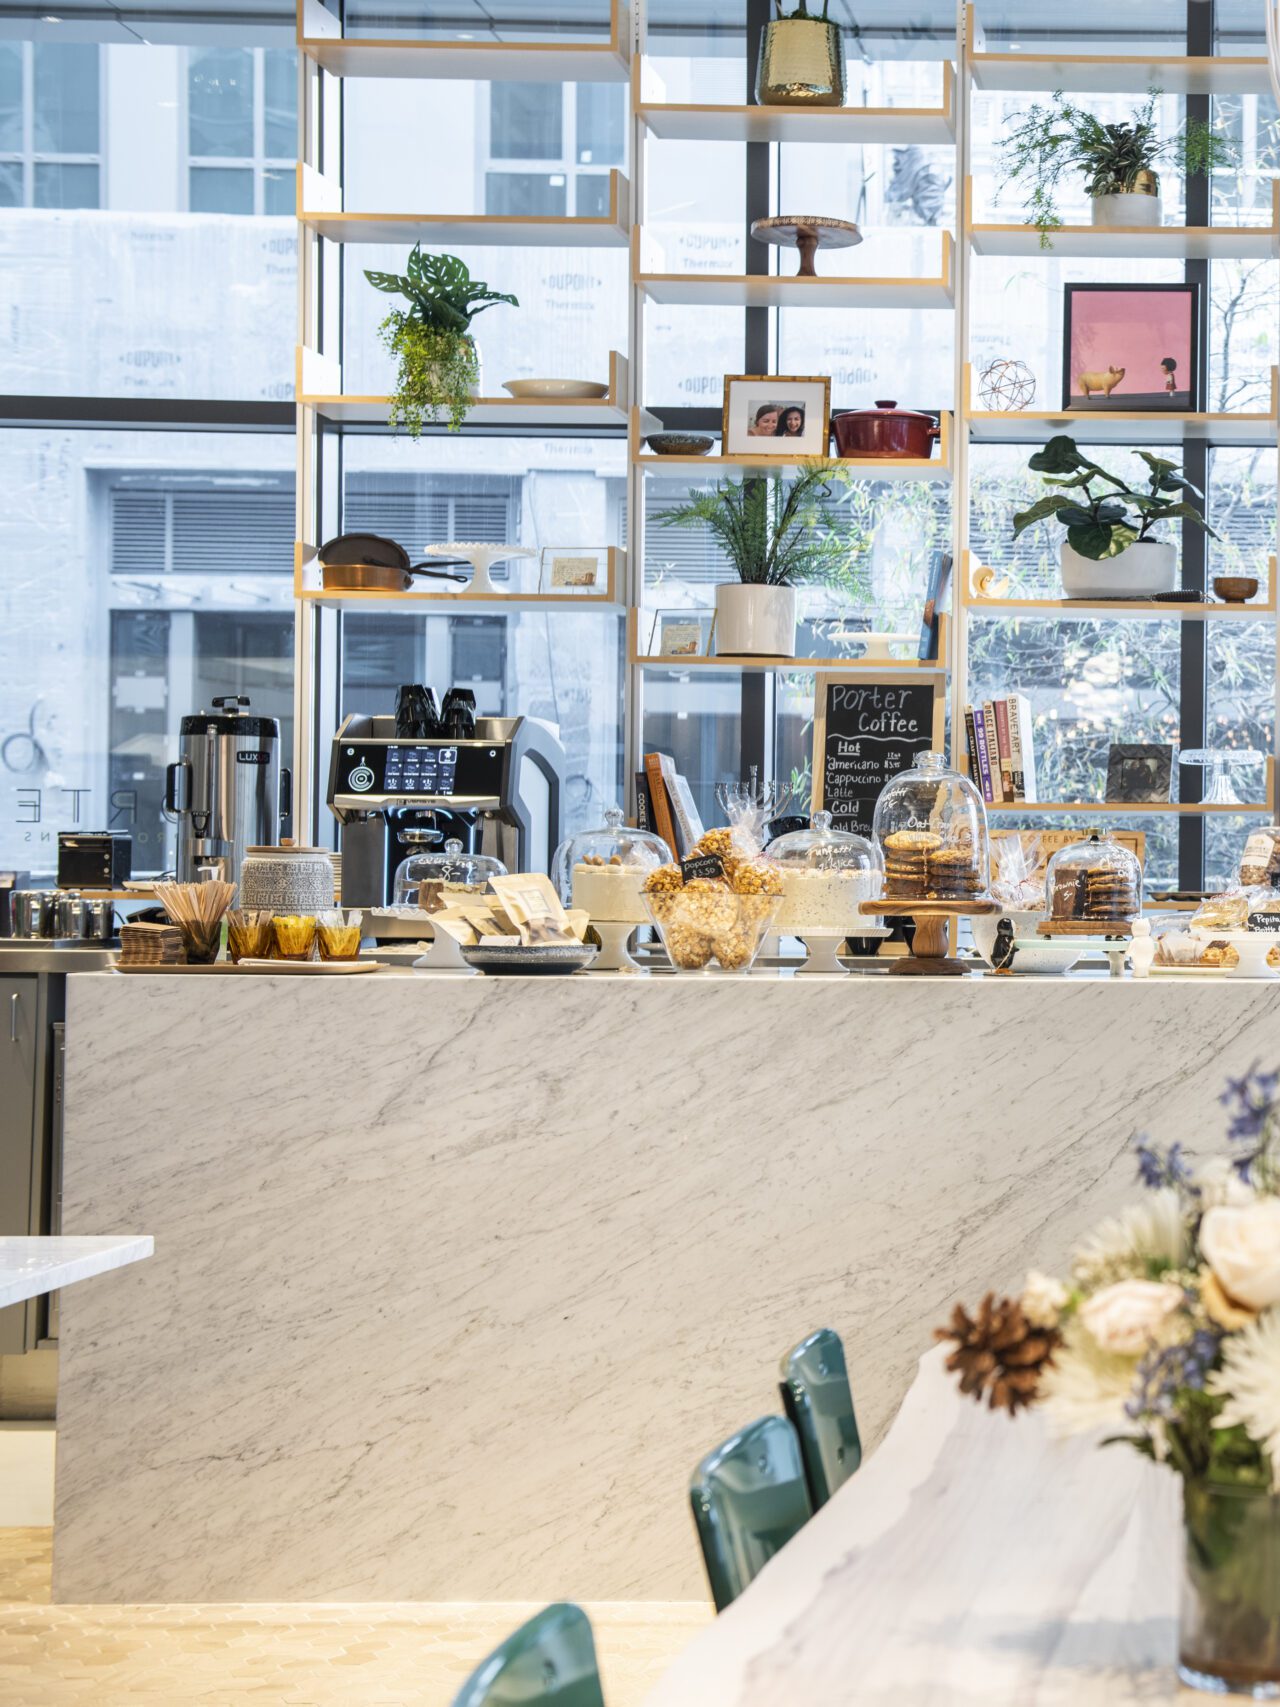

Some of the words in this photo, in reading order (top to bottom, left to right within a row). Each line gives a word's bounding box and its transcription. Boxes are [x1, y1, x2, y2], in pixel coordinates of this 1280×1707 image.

[832, 685, 913, 712] Porter
[858, 711, 919, 733] Coffee
[984, 704, 993, 729] DOLCE
[1008, 698, 1021, 755] BRAVETART
[977, 727, 985, 738] 99
[837, 741, 861, 754] Hot
[979, 738, 989, 775] BOTTLES
[986, 729, 998, 766] ITALIANO
[826, 786, 854, 798] Latte
[638, 792, 647, 824] COOKIE
[831, 800, 860, 814] Cold
[1063, 835, 1076, 844] BY
[1252, 912, 1280, 925] Pepita
